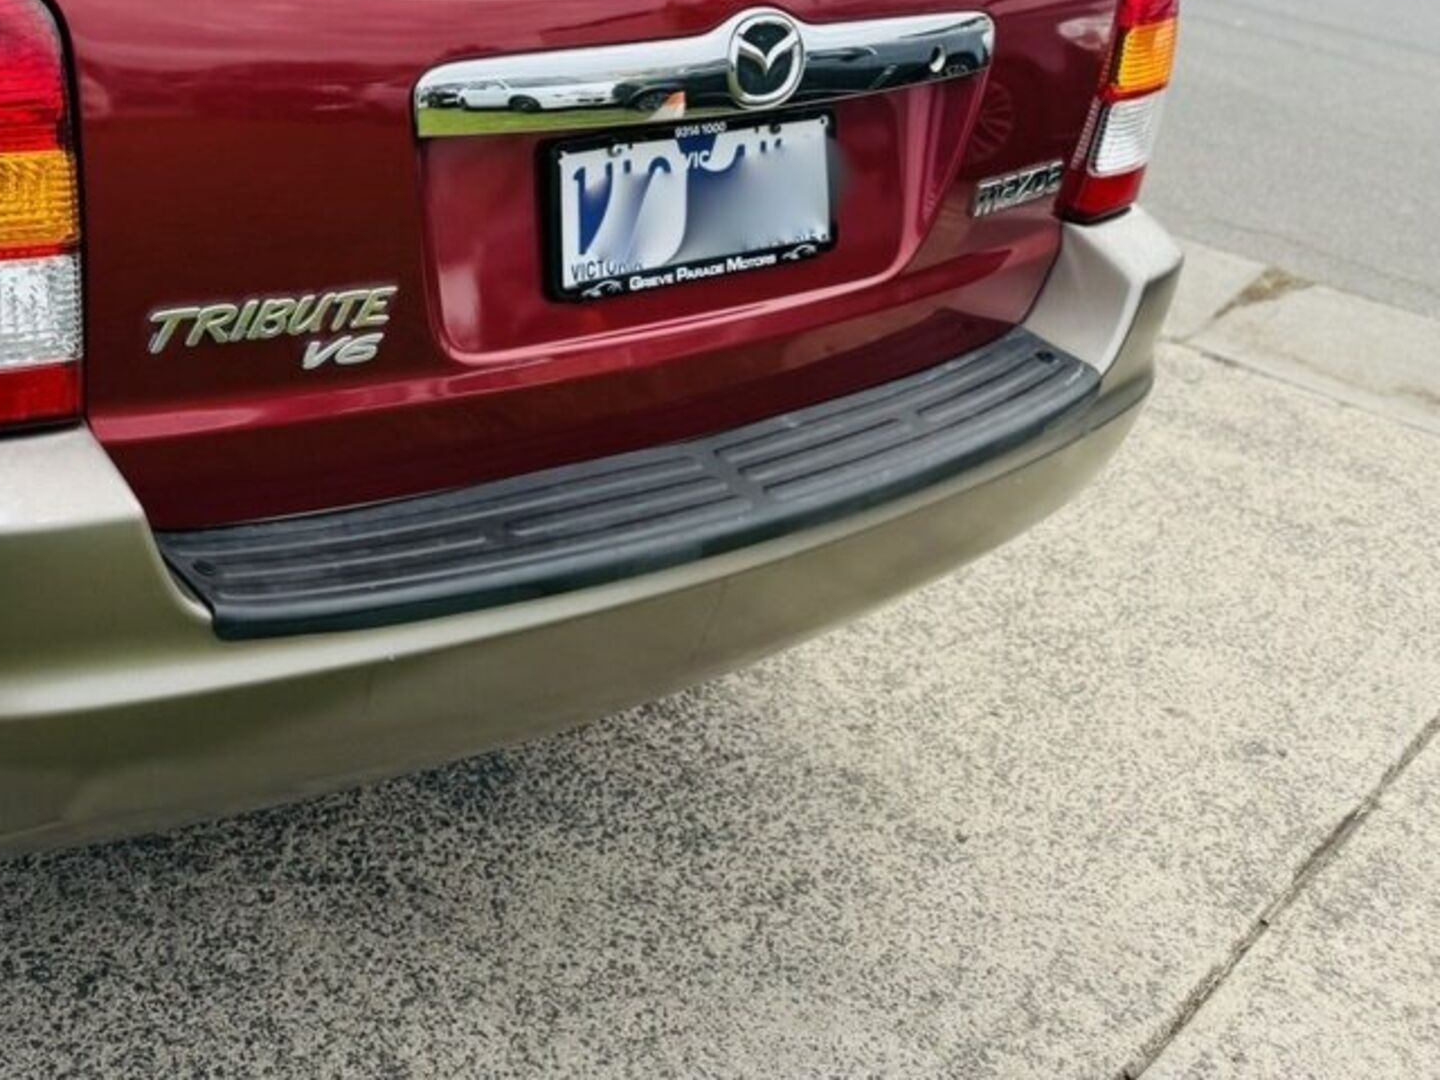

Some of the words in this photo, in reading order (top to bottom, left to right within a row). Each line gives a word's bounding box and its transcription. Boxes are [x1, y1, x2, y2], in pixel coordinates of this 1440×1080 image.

[675, 124, 700, 138] 9314
[702, 121, 728, 135] 1000
[148, 285, 399, 354] TRIBUTE
[302, 332, 384, 371] V6
